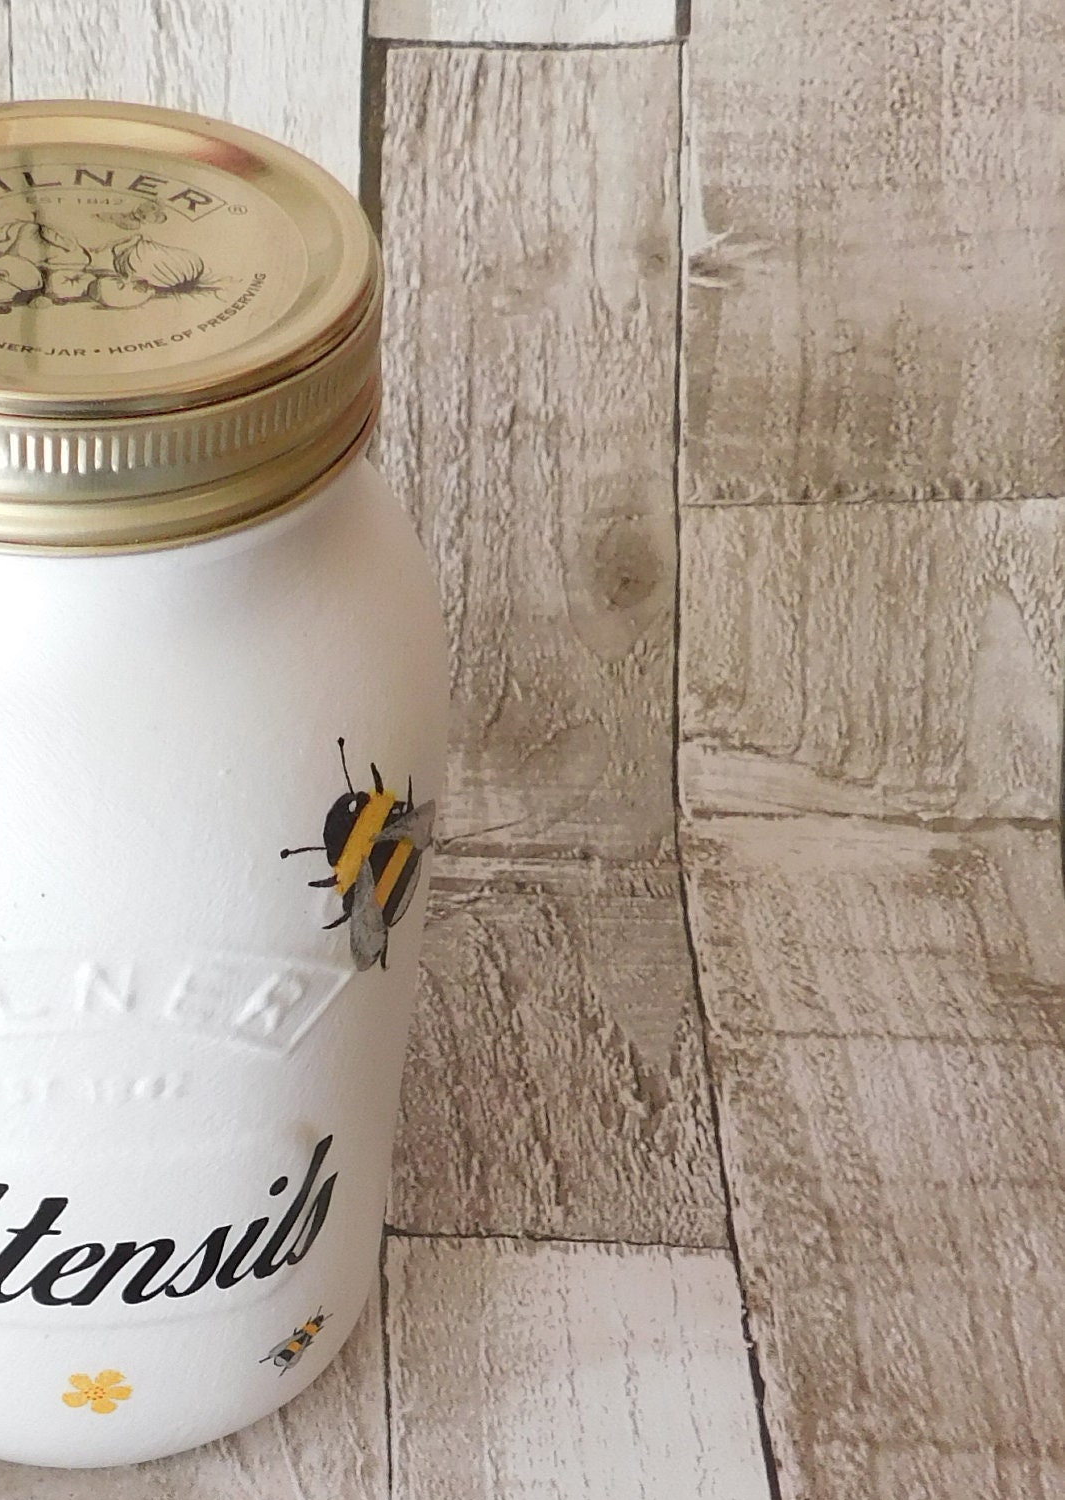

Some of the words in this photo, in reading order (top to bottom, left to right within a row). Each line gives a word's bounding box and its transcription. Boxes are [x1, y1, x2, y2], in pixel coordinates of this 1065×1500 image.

[44, 346, 87, 357] JAR
[109, 337, 166, 355] HOME
[170, 328, 193, 342] OF
[197, 271, 268, 333] PRESERVING
